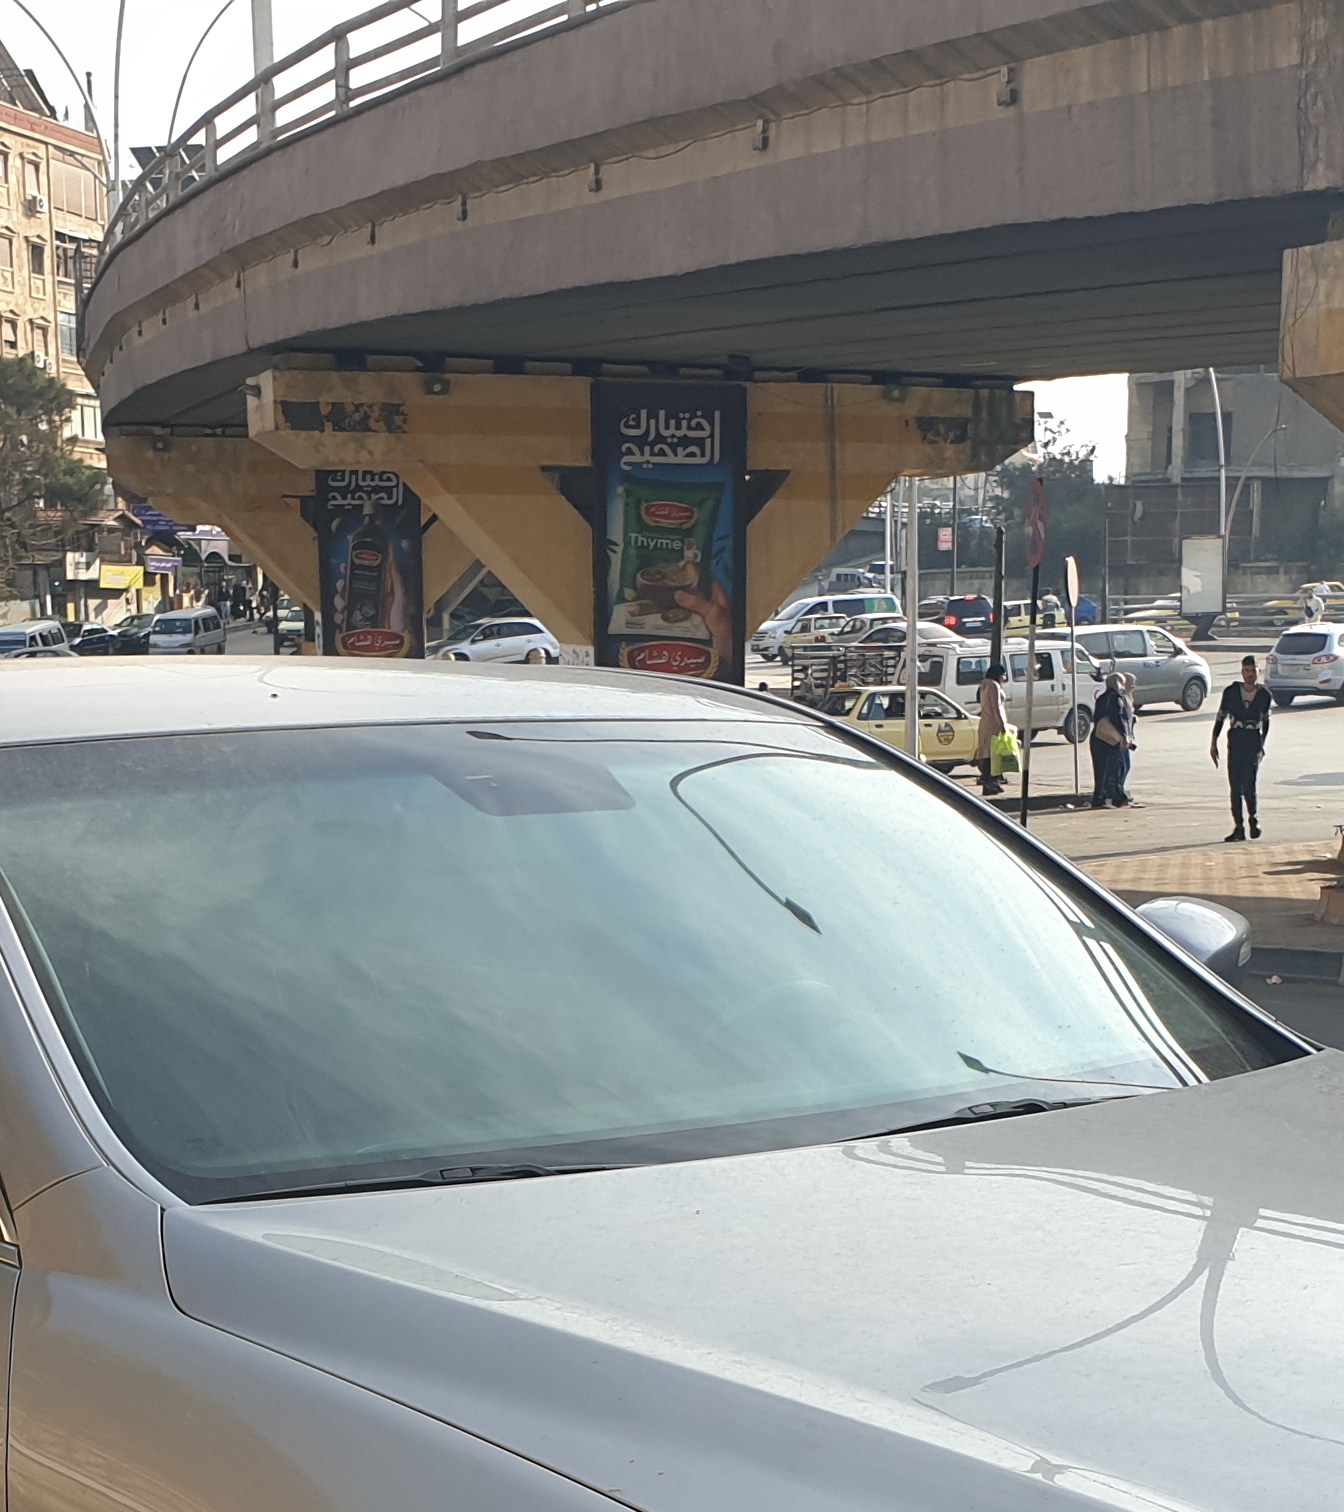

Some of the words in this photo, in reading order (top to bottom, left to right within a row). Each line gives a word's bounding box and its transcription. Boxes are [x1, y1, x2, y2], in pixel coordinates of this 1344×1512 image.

[619, 408, 721, 443] اختيارك
[628, 532, 683, 551] Thyme
[635, 648, 669, 669] هشام
[670, 650, 706, 670] سيدي
